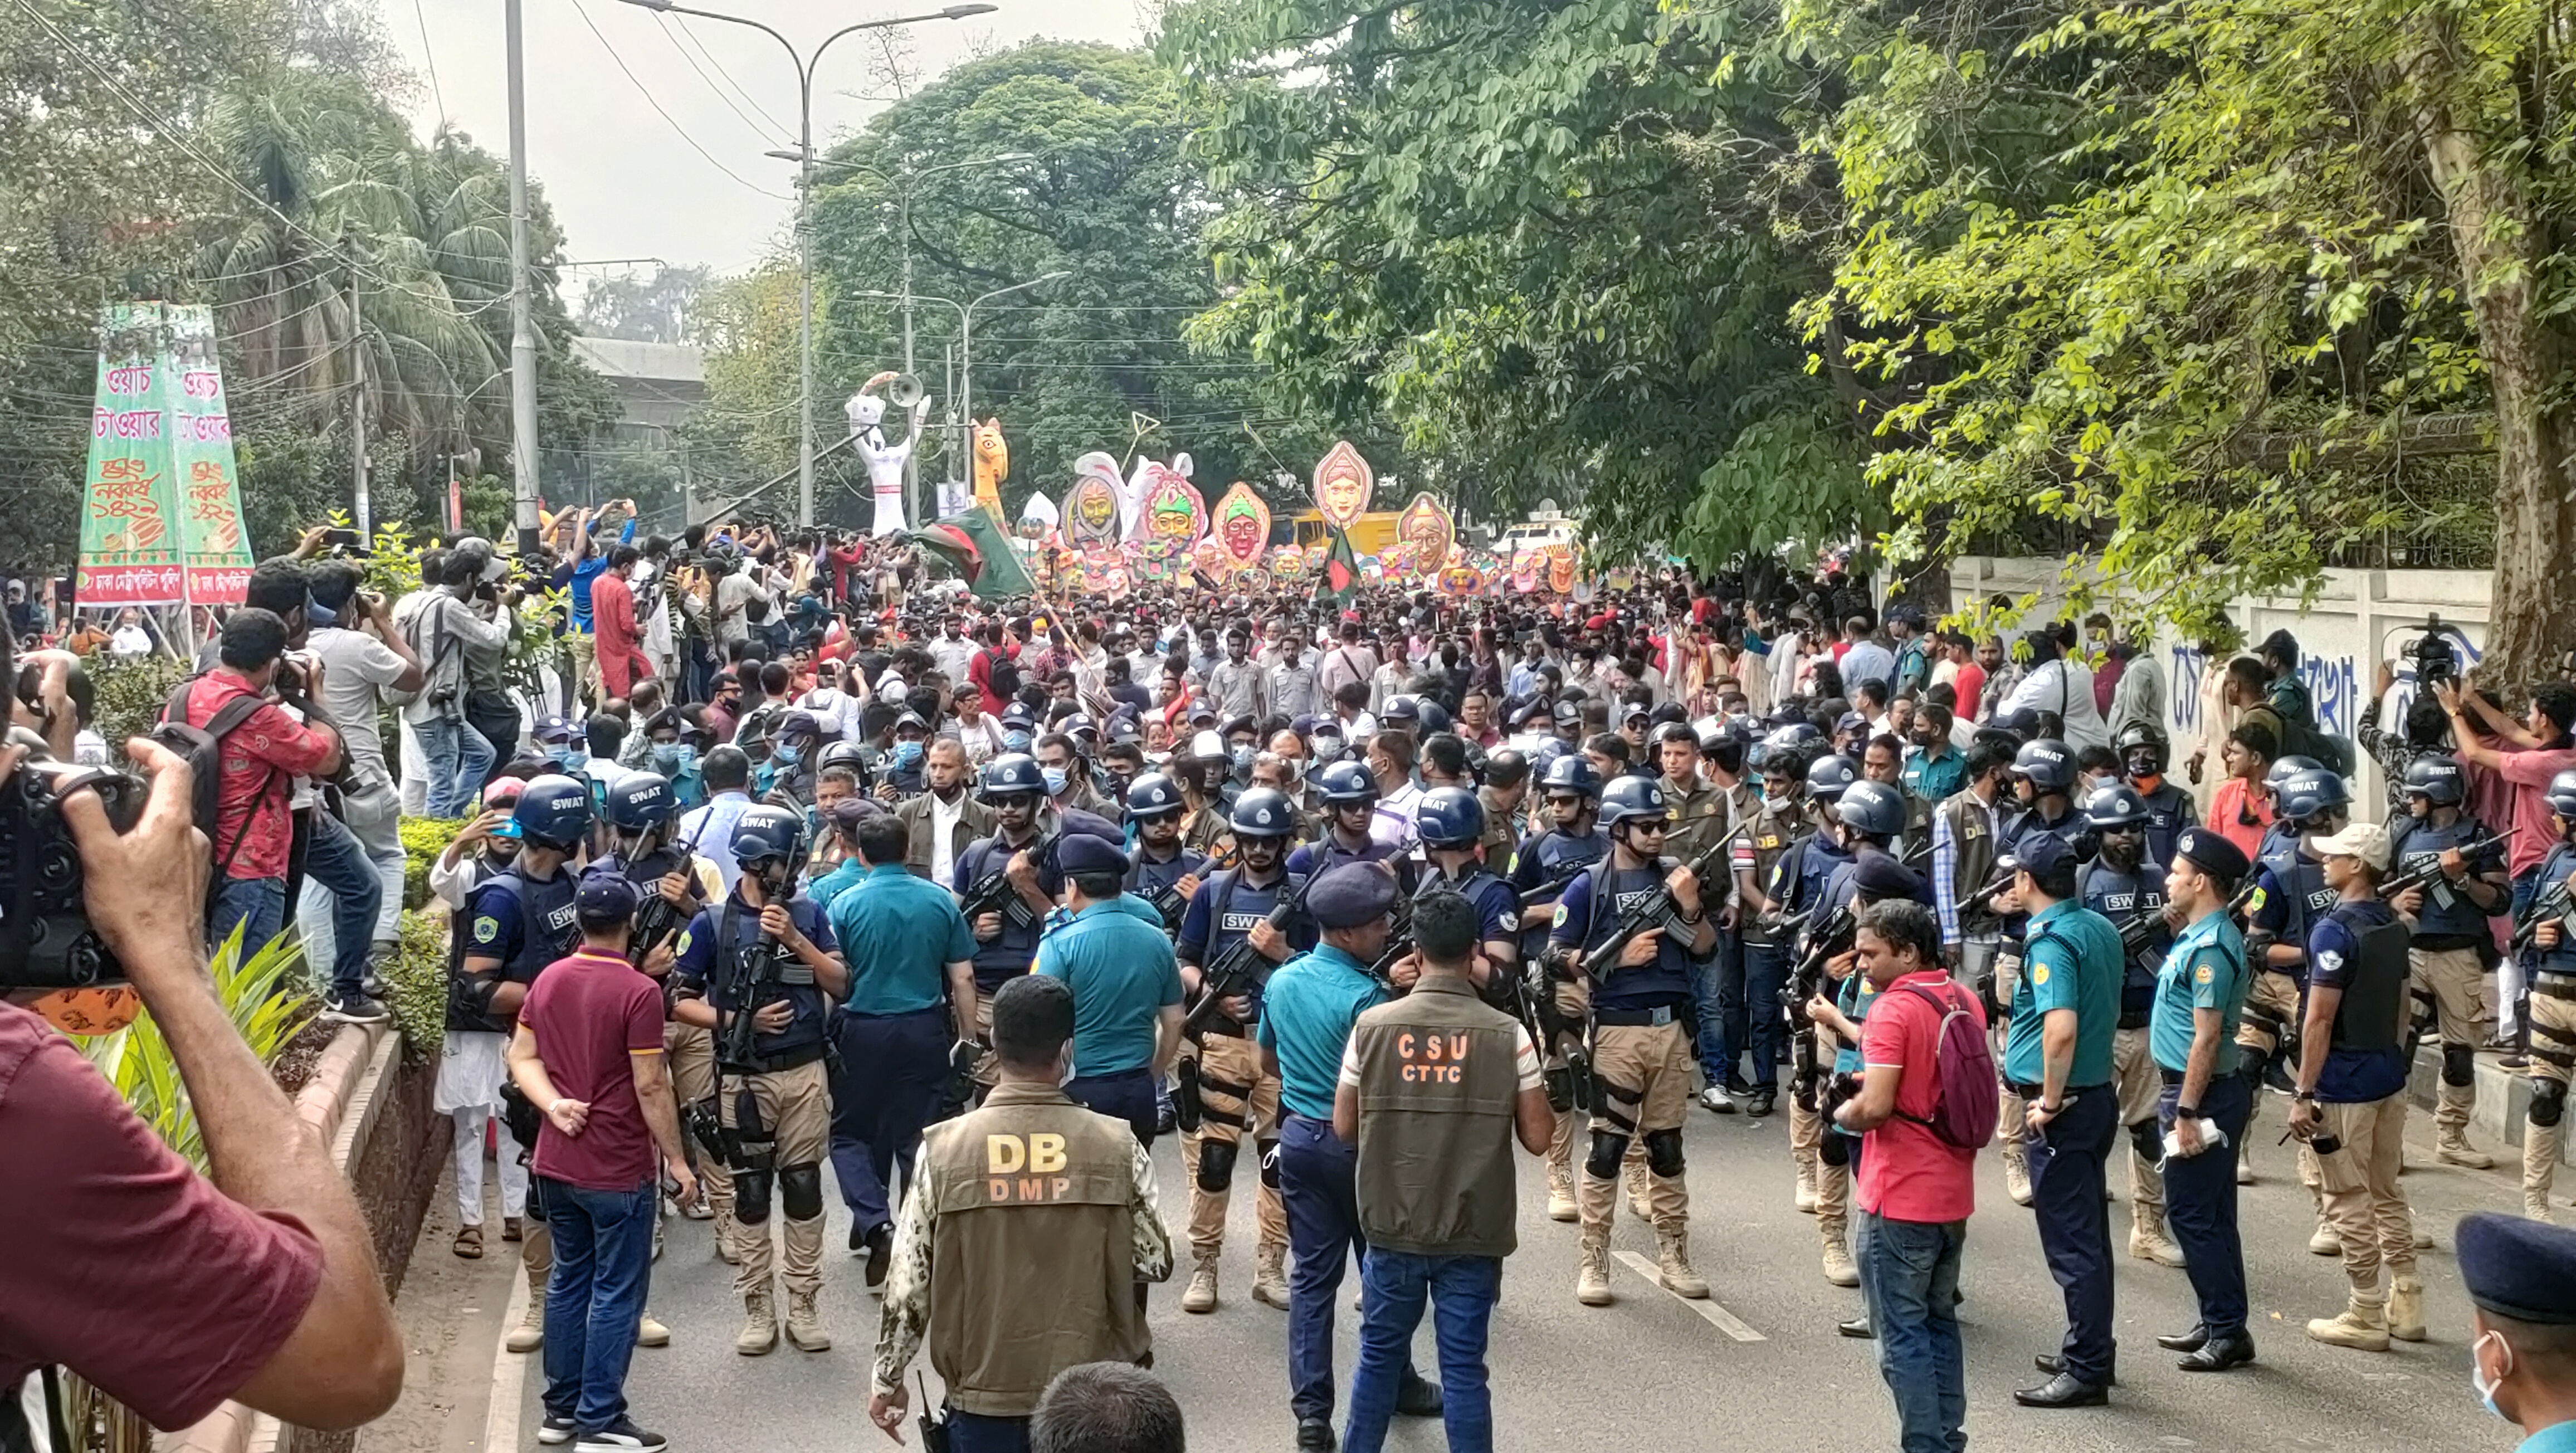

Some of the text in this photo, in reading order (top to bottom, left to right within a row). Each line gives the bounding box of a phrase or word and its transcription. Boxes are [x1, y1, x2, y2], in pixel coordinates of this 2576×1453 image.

[106, 367, 152, 393] ওয়াচ
[95, 407, 162, 440] টাওয়ার
[91, 498, 159, 519] ১৪২৯
[2033, 748, 2065, 762] SWAT
[2428, 766, 2456, 775] SWAT
[629, 786, 662, 804] SWAT
[2287, 781, 2319, 792] SWAT
[552, 796, 585, 811] SWAT
[739, 817, 777, 829] SWAT
[1755, 835, 1778, 849] DB
[2110, 895, 2156, 907] SWT
[2314, 889, 2336, 905] SW
[554, 906, 577, 925] SW
[1227, 915, 1253, 928] SW
[1398, 1033, 1467, 1060] CSU
[1402, 1065, 1461, 1083] CTTC
[987, 1133, 1067, 1174] DB
[989, 1177, 1070, 1202] DMP
